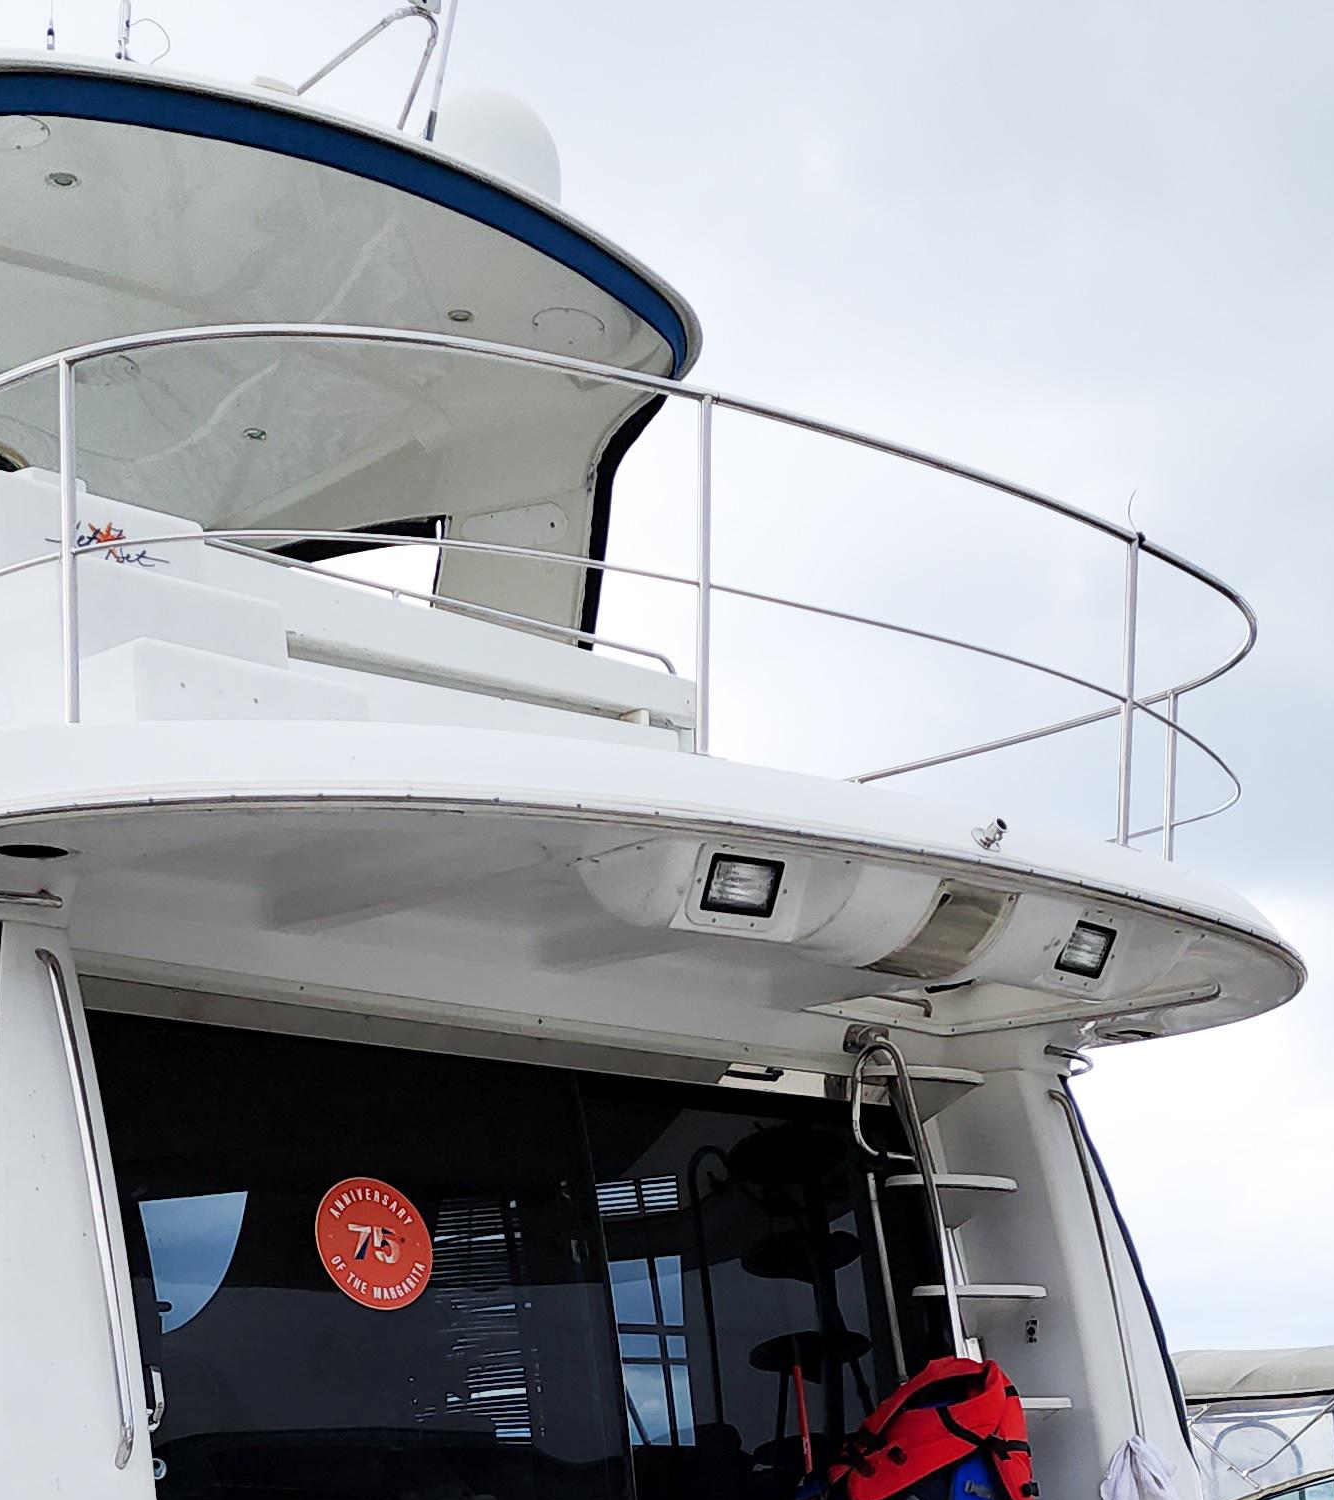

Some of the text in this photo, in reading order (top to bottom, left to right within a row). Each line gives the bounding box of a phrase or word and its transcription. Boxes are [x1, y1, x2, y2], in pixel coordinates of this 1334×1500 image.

[329, 1187, 413, 1225] ANNIVERSARY
[347, 1223, 399, 1264] 75
[331, 1255, 426, 1299] OF THE MARGARITA
